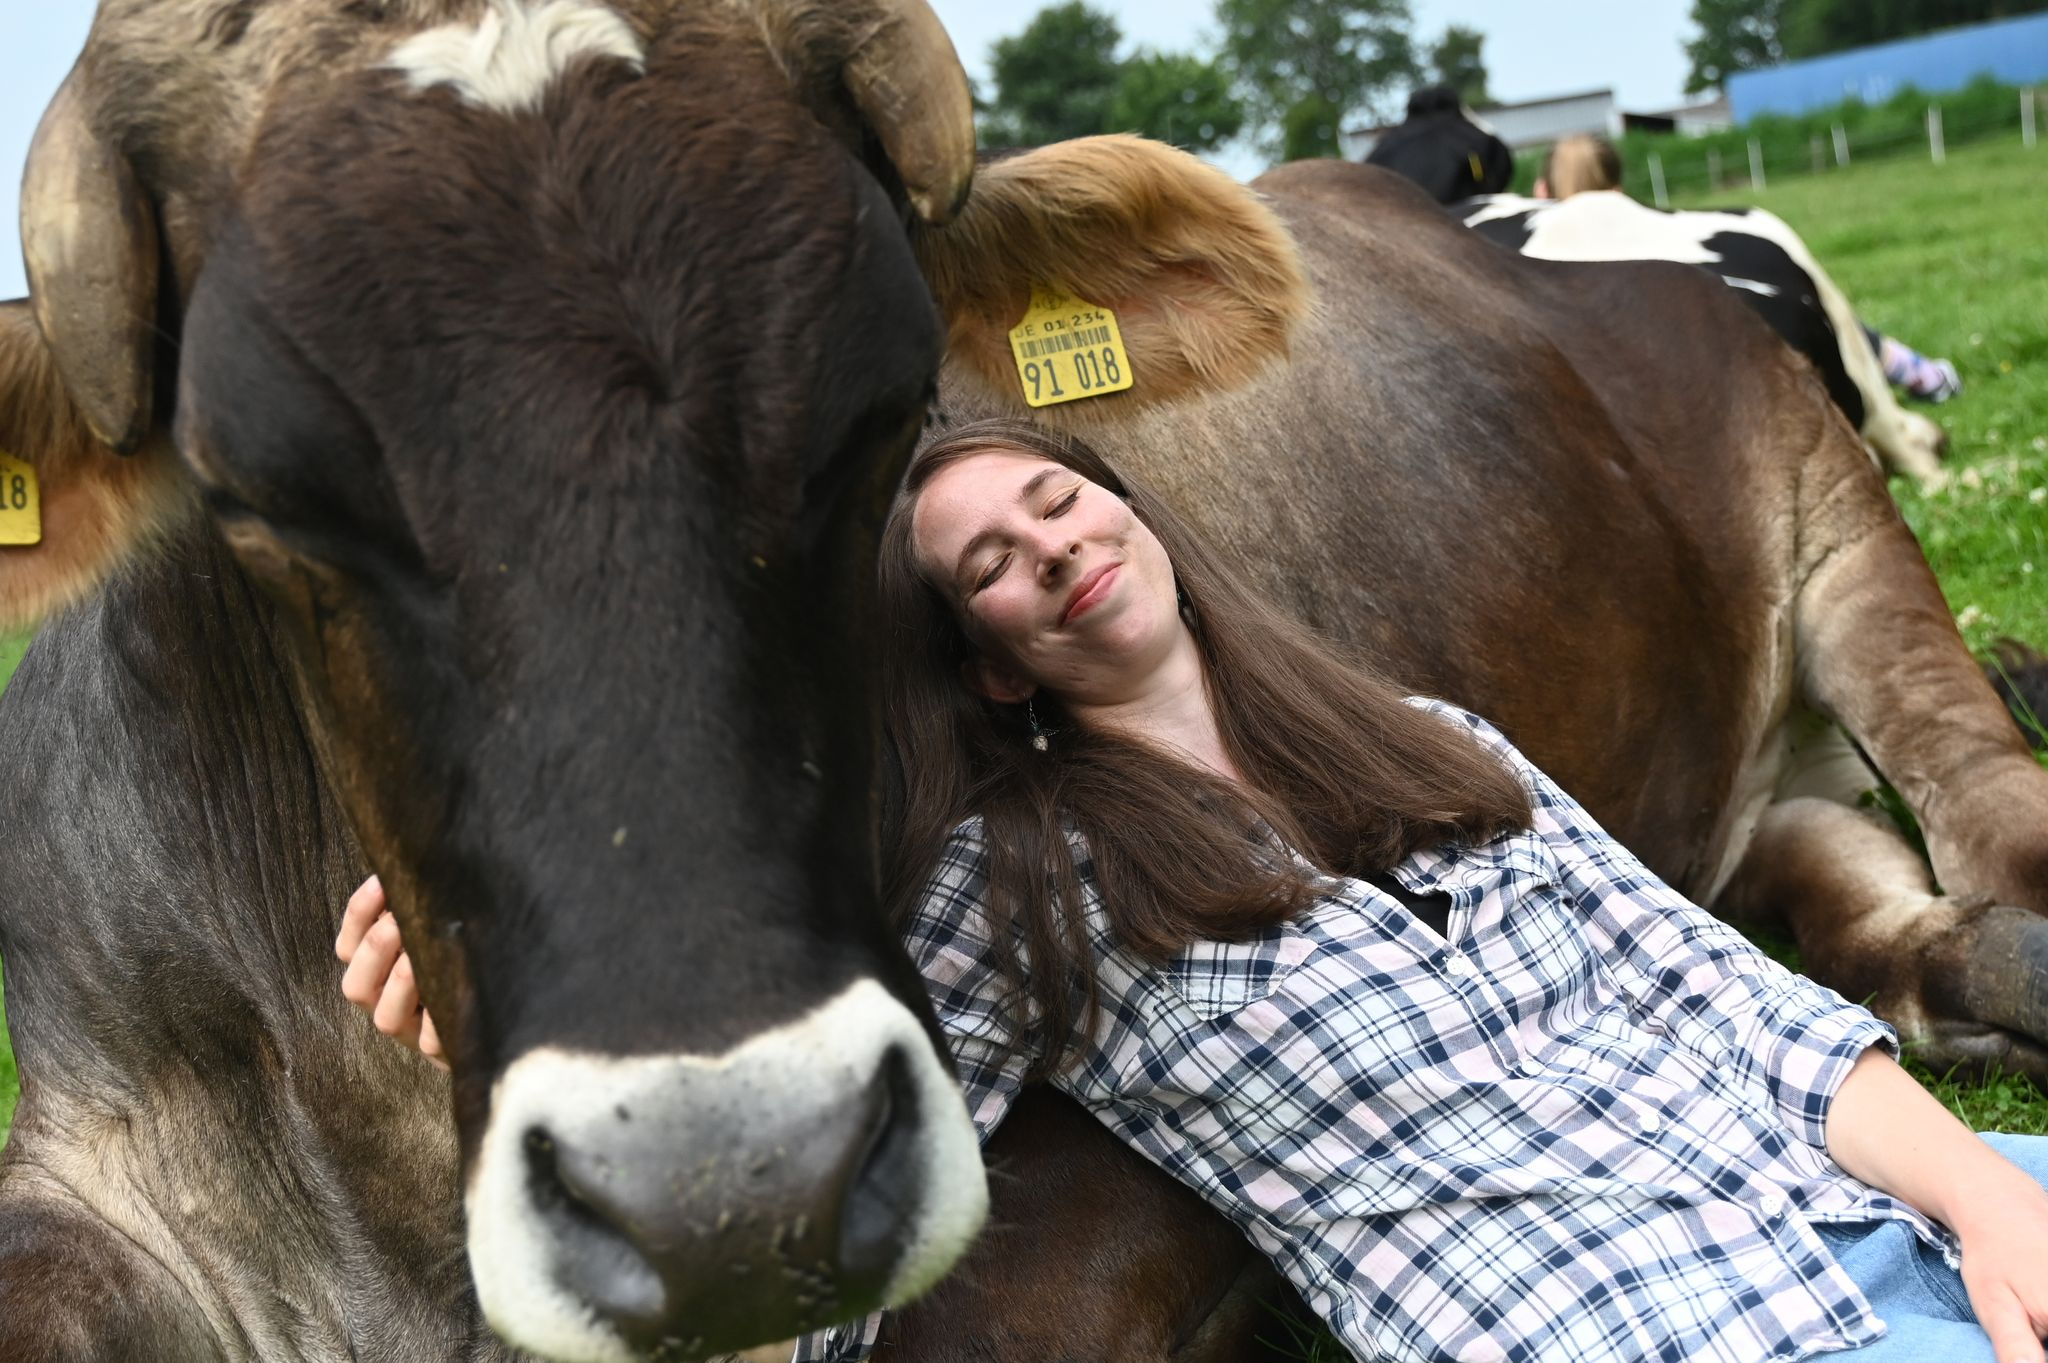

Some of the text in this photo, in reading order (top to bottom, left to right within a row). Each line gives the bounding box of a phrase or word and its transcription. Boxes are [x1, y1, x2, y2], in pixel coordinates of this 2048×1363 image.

[1044, 320, 1066, 332] 01
[1071, 311, 1105, 326] 234
[1024, 346, 1120, 400] 91 018
